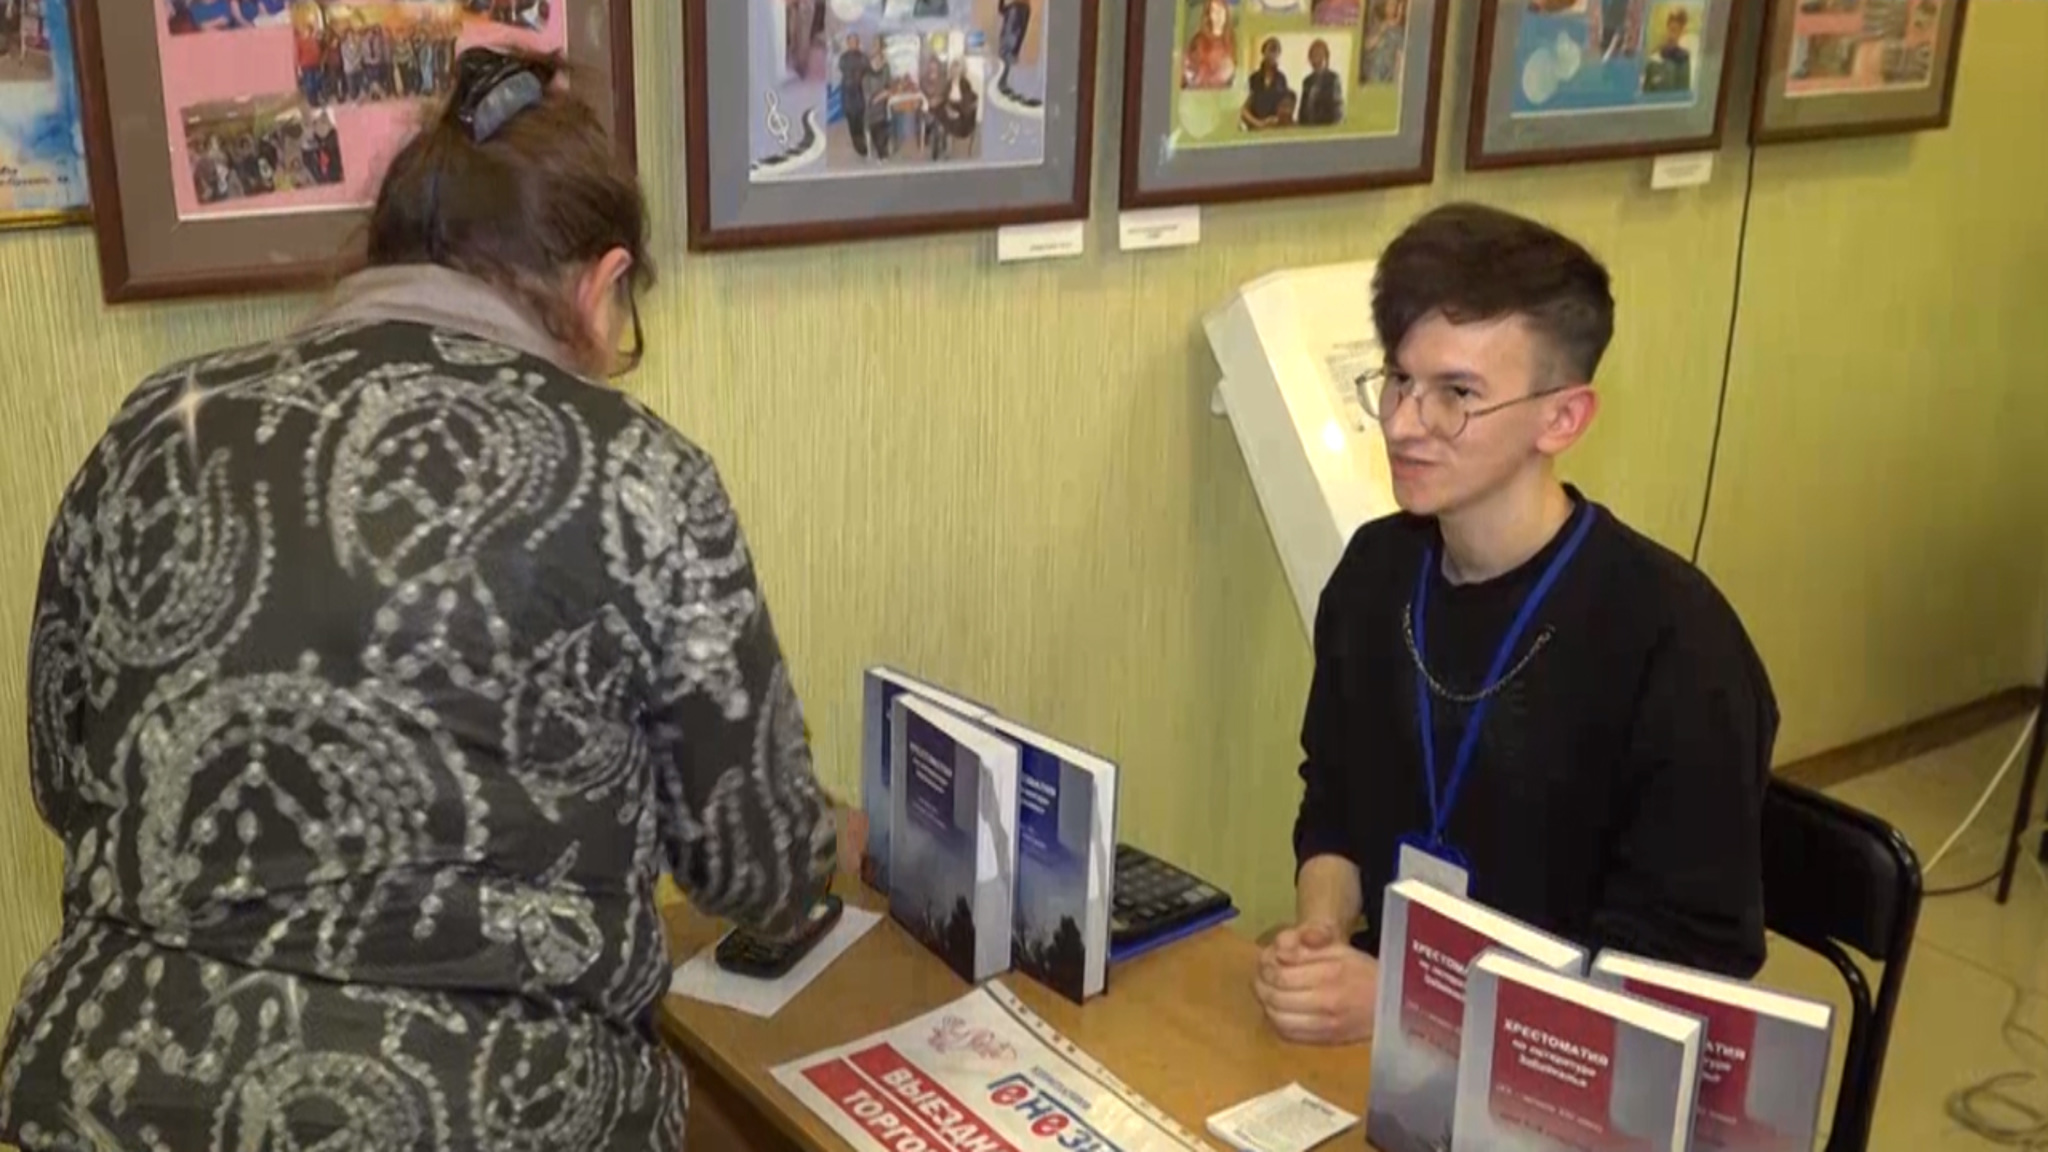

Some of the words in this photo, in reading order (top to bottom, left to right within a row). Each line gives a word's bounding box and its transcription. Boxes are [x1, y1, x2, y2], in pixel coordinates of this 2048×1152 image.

[1412, 939, 1467, 976] ХРЕСТОМ
[1504, 1018, 1609, 1067] ХРЕСТОМАТИЯ
[842, 1088, 934, 1152] ТОРГО
[881, 1066, 1003, 1152] ВЫЕЗДН
